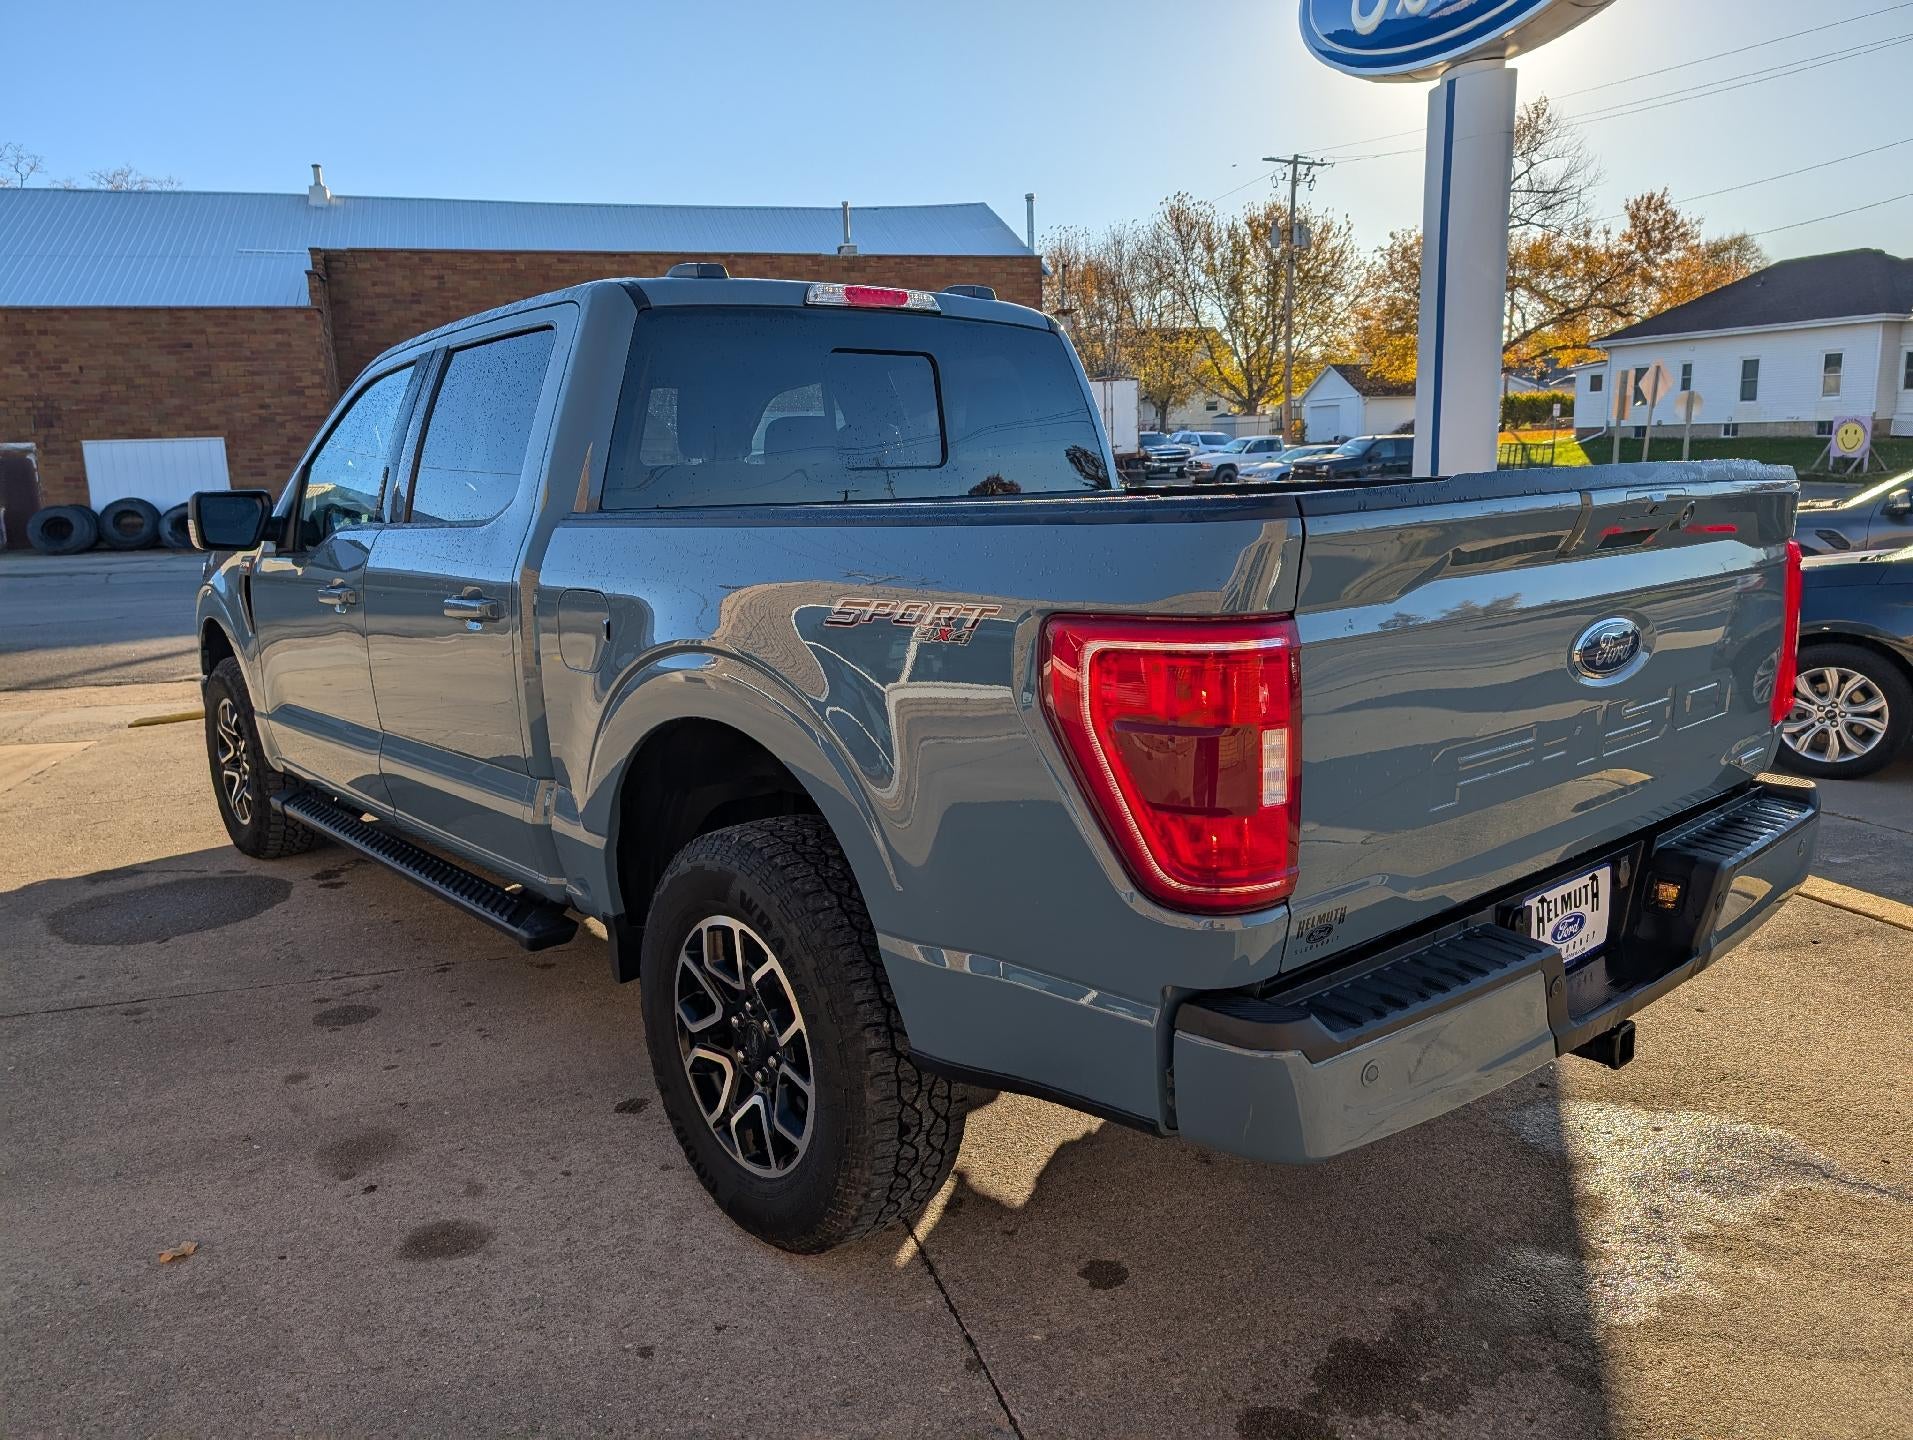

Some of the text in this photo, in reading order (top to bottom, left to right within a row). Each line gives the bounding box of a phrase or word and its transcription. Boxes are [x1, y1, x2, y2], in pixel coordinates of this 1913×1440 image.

[824, 597, 1002, 629] SPORT
[1596, 632, 1634, 666] Ford
[1428, 671, 1735, 812] F-150
[1296, 905, 1348, 940] HELMUTH
[1536, 872, 1600, 940] HELMUTH
[1556, 916, 1580, 941] Ford
